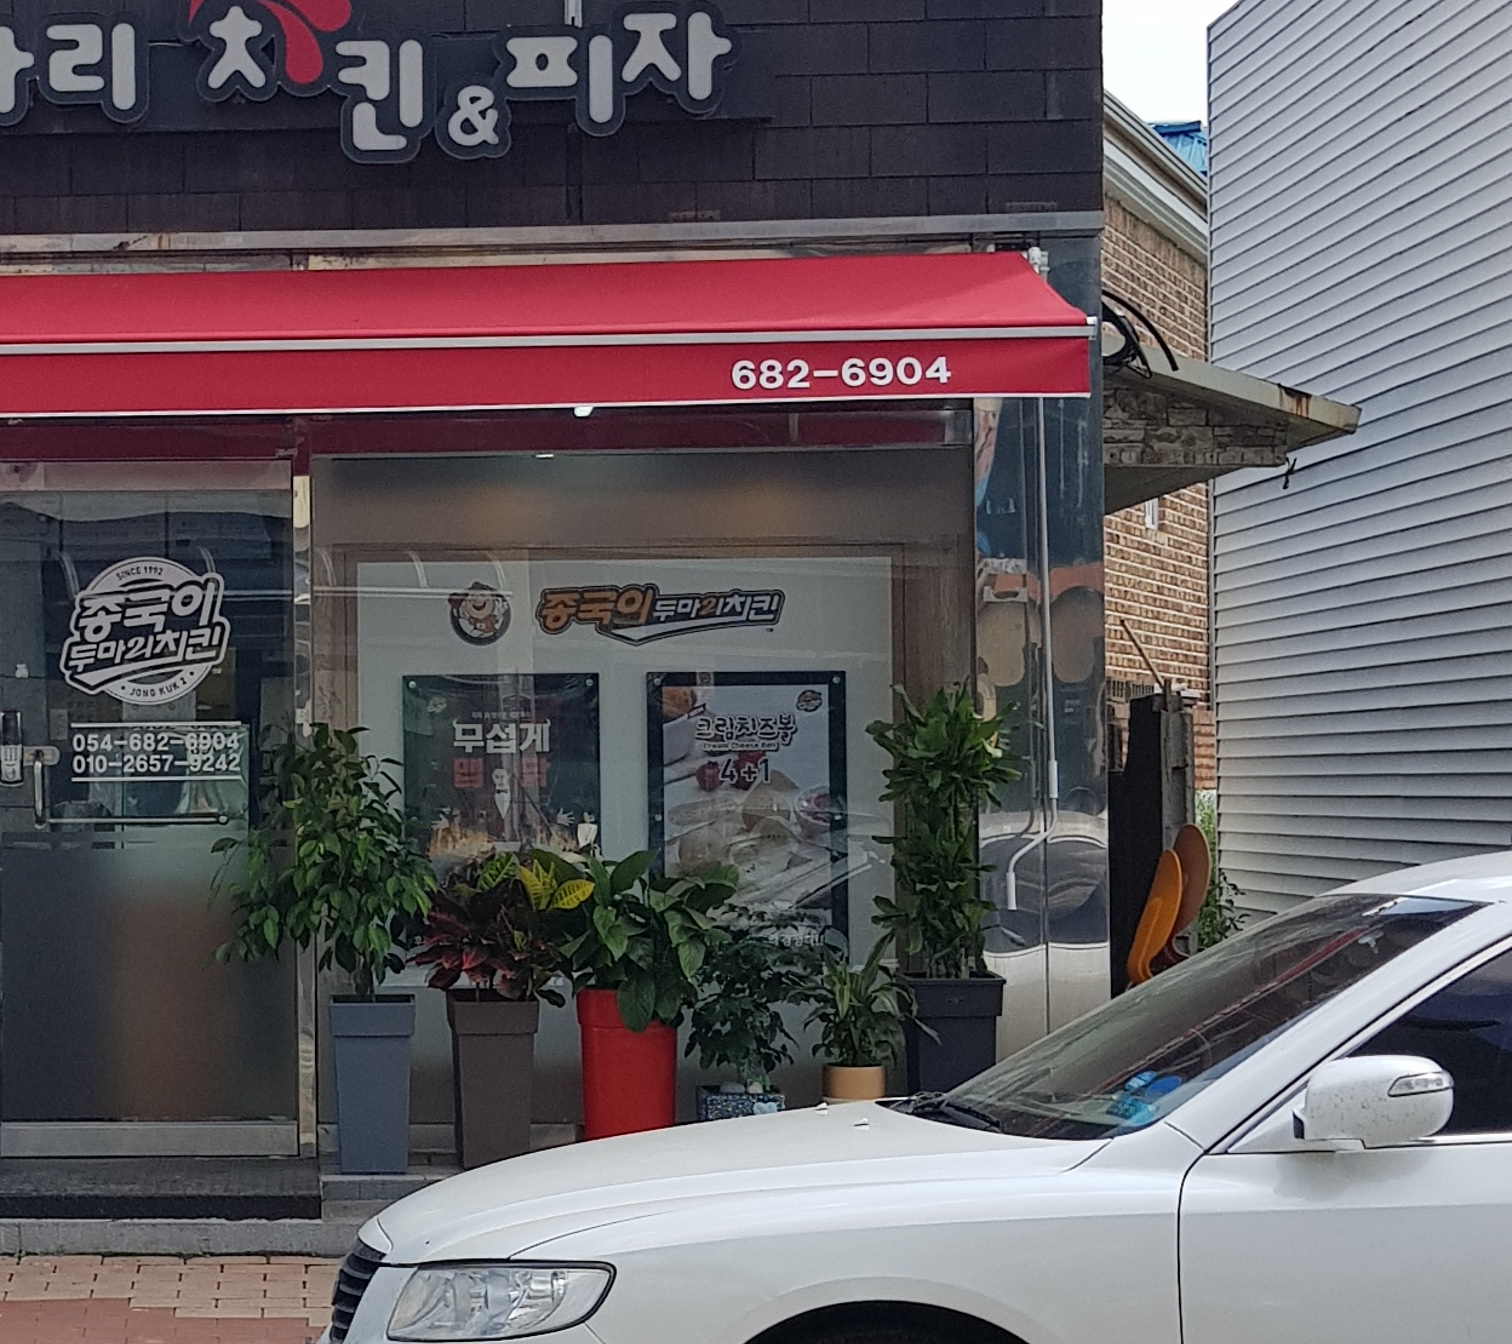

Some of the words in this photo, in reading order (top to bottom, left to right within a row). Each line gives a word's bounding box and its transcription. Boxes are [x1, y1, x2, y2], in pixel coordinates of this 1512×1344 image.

[731, 356, 952, 390] 682-6904
[116, 566, 141, 581] SINCE
[78, 581, 216, 643] 종국이
[542, 588, 654, 631] 종국이
[651, 593, 780, 623] 두마리치킨
[67, 625, 222, 672] 두마리치킨
[72, 732, 240, 753] 054-682-6904
[452, 718, 552, 754] 무섭게
[694, 712, 796, 744] 크림치즈볼
[72, 754, 241, 774] 010-2657-9242
